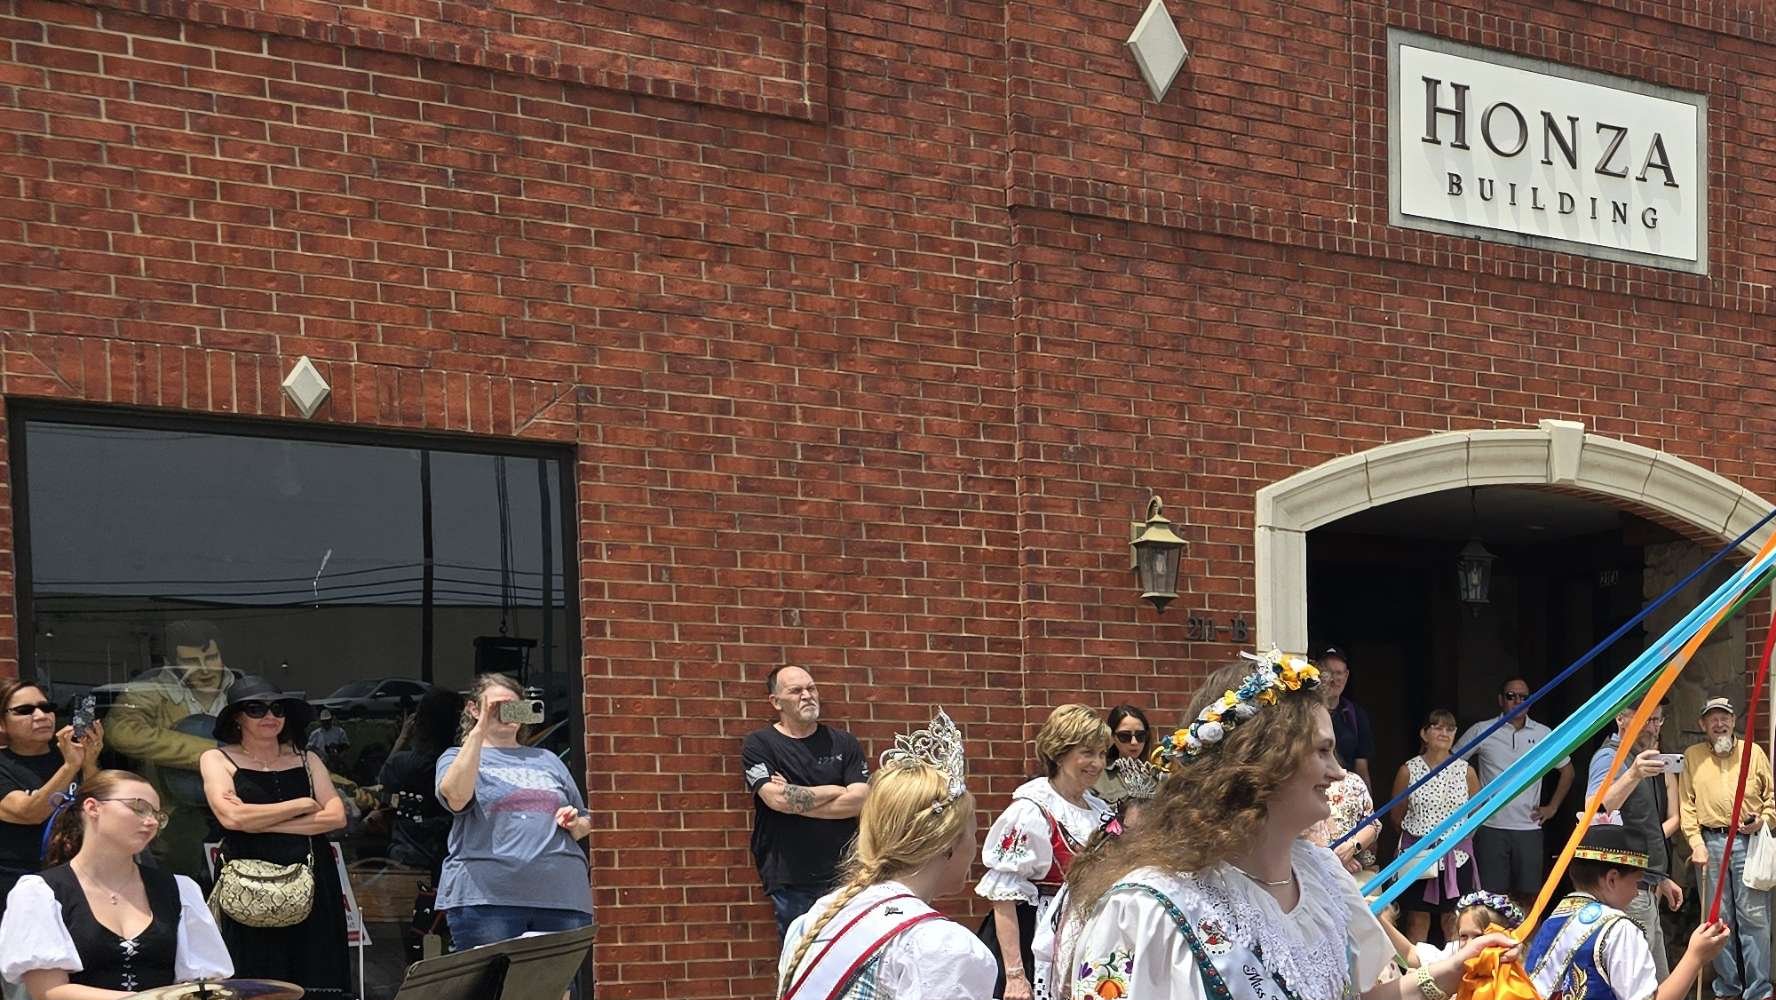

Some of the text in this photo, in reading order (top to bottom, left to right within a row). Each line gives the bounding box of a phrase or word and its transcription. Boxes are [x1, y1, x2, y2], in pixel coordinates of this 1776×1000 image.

[1421, 75, 1680, 189] HONZA
[1447, 171, 1659, 229] BUILDING
[1242, 964, 1267, 999] Miss
